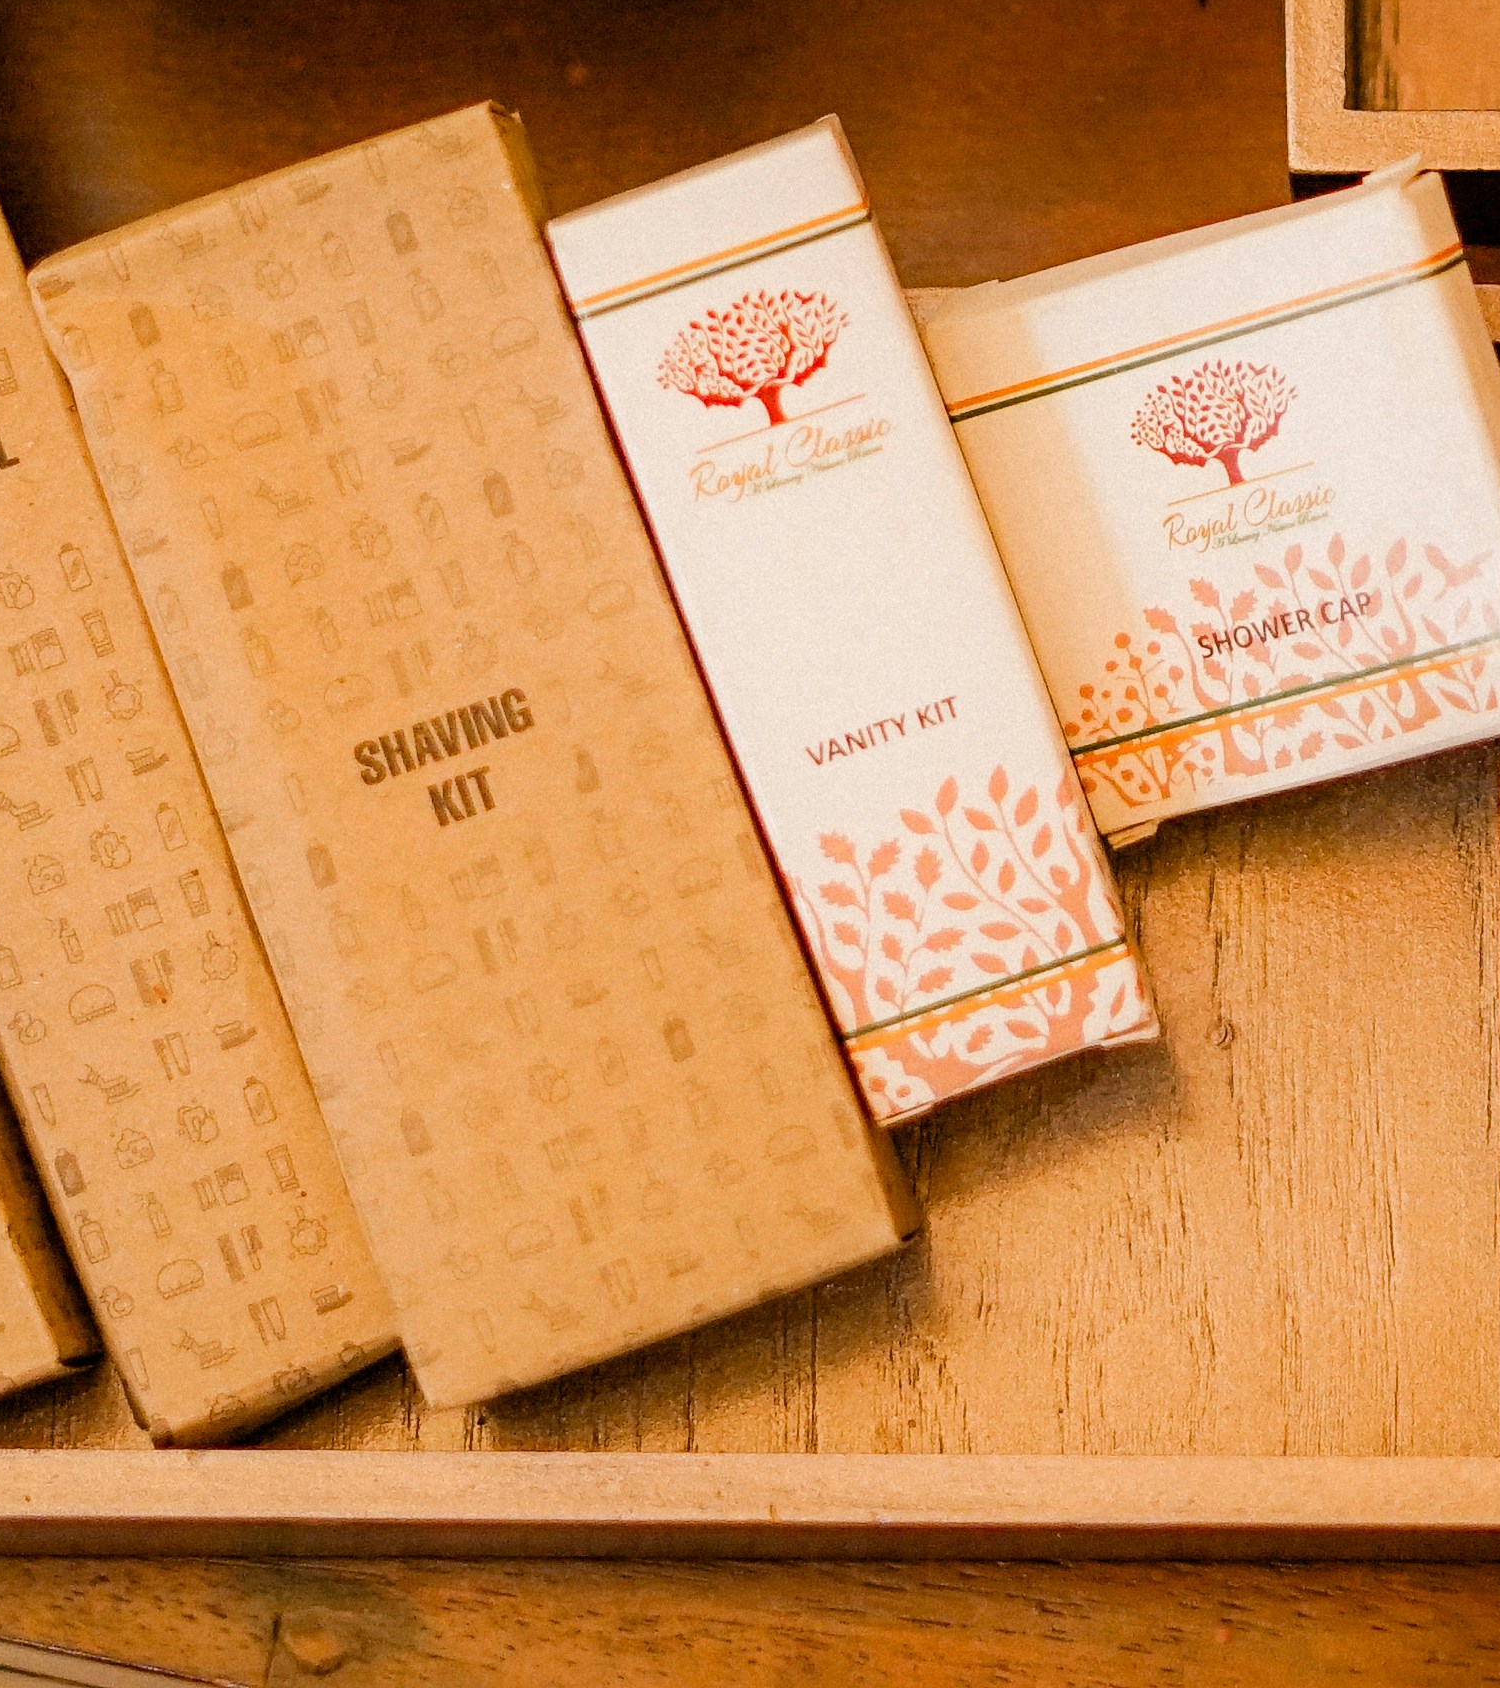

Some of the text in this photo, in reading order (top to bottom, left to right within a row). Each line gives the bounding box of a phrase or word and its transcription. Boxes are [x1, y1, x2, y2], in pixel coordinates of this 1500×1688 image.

[689, 443, 778, 502] Royal
[785, 416, 892, 468] Classic
[1163, 503, 1238, 553] Royal
[1244, 485, 1336, 526] Classic
[1197, 590, 1373, 660] SHOWER CAP
[353, 687, 536, 786] SHAVING
[805, 695, 959, 767] VANITY KIT
[426, 765, 497, 828] KIT
